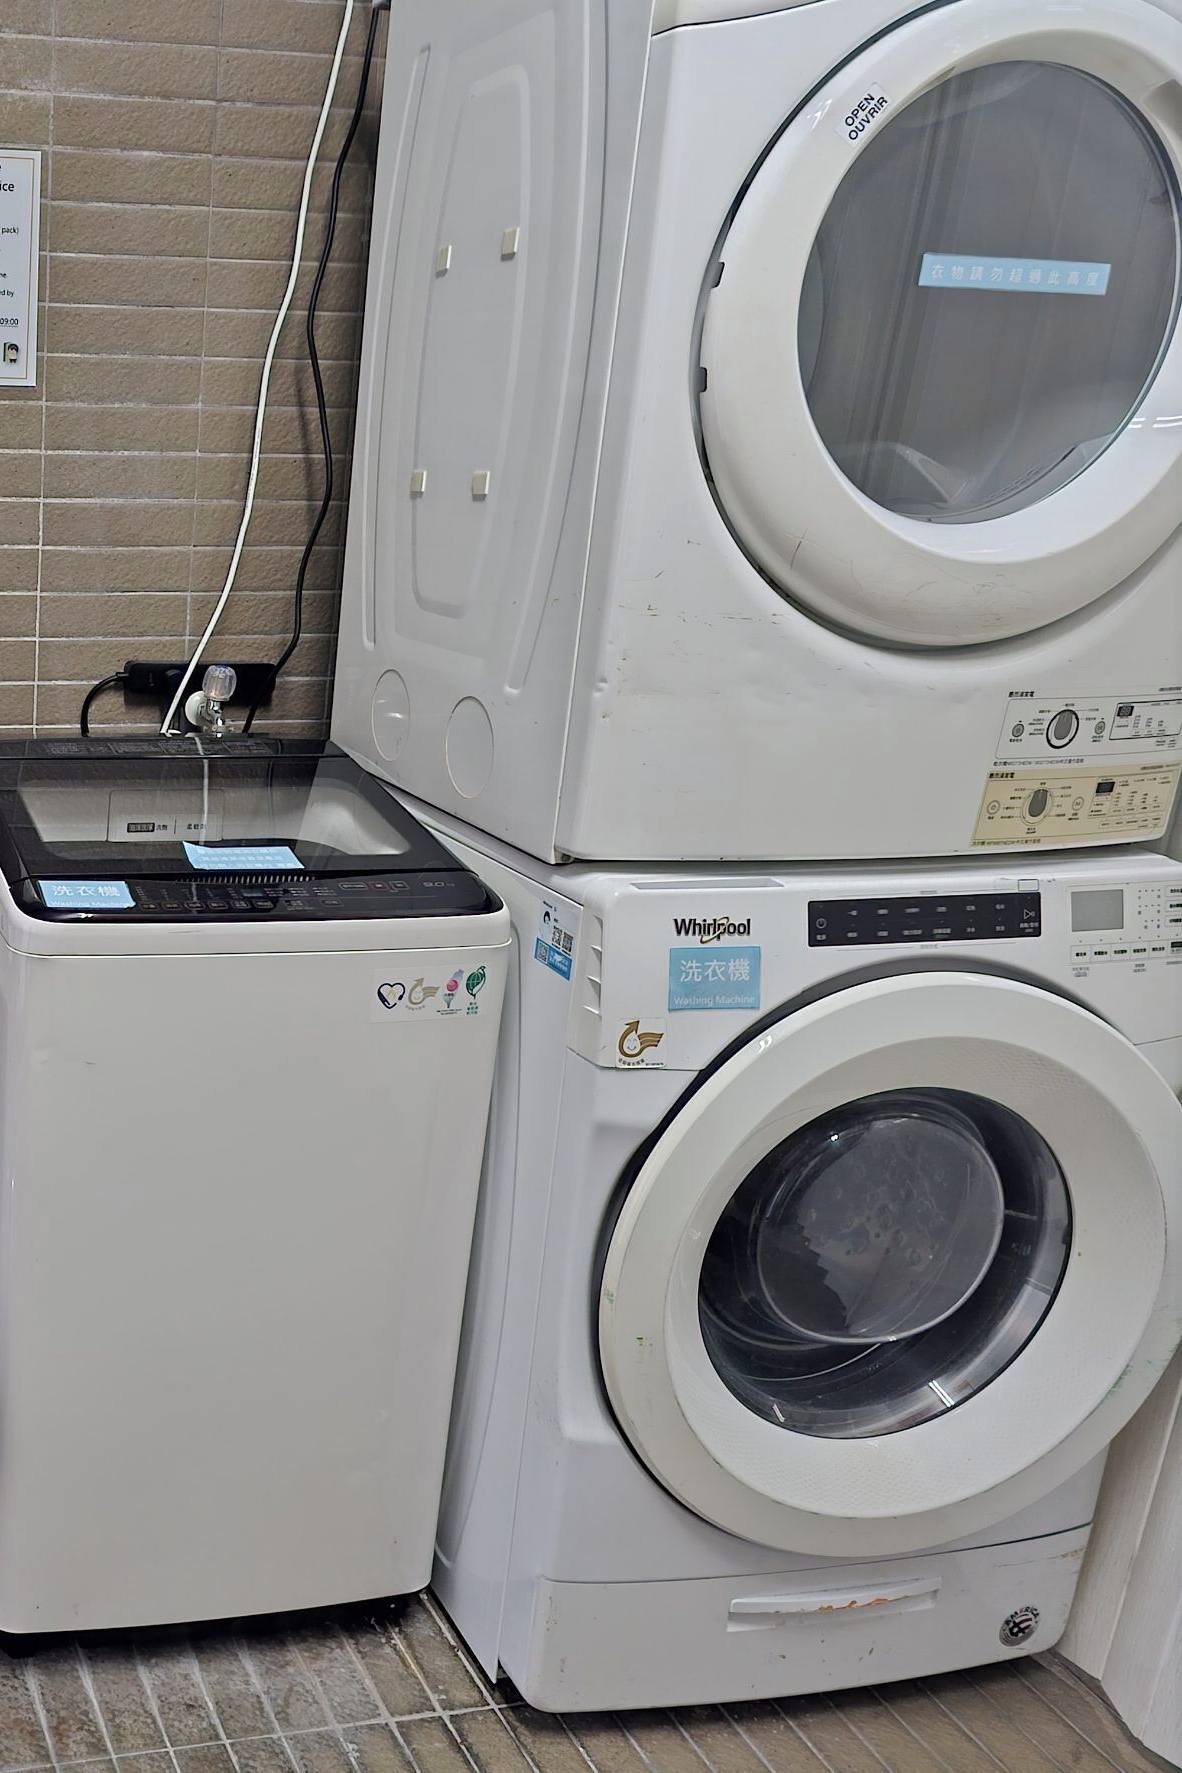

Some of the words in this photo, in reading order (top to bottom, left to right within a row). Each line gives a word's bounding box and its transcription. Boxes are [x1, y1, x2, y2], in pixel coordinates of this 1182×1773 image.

[845, 93, 875, 126] OPEN
[848, 96, 888, 140] OUVRIR
[931, 263, 1100, 287] 衣物請勿超過此高度
[6, 290, 14, 298] by
[52, 885, 121, 897] 洗衣機
[673, 918, 751, 941] Whirlpool
[680, 958, 750, 982] 洗衣機
[673, 996, 713, 1006] Washing
[715, 995, 755, 1005] Machine
